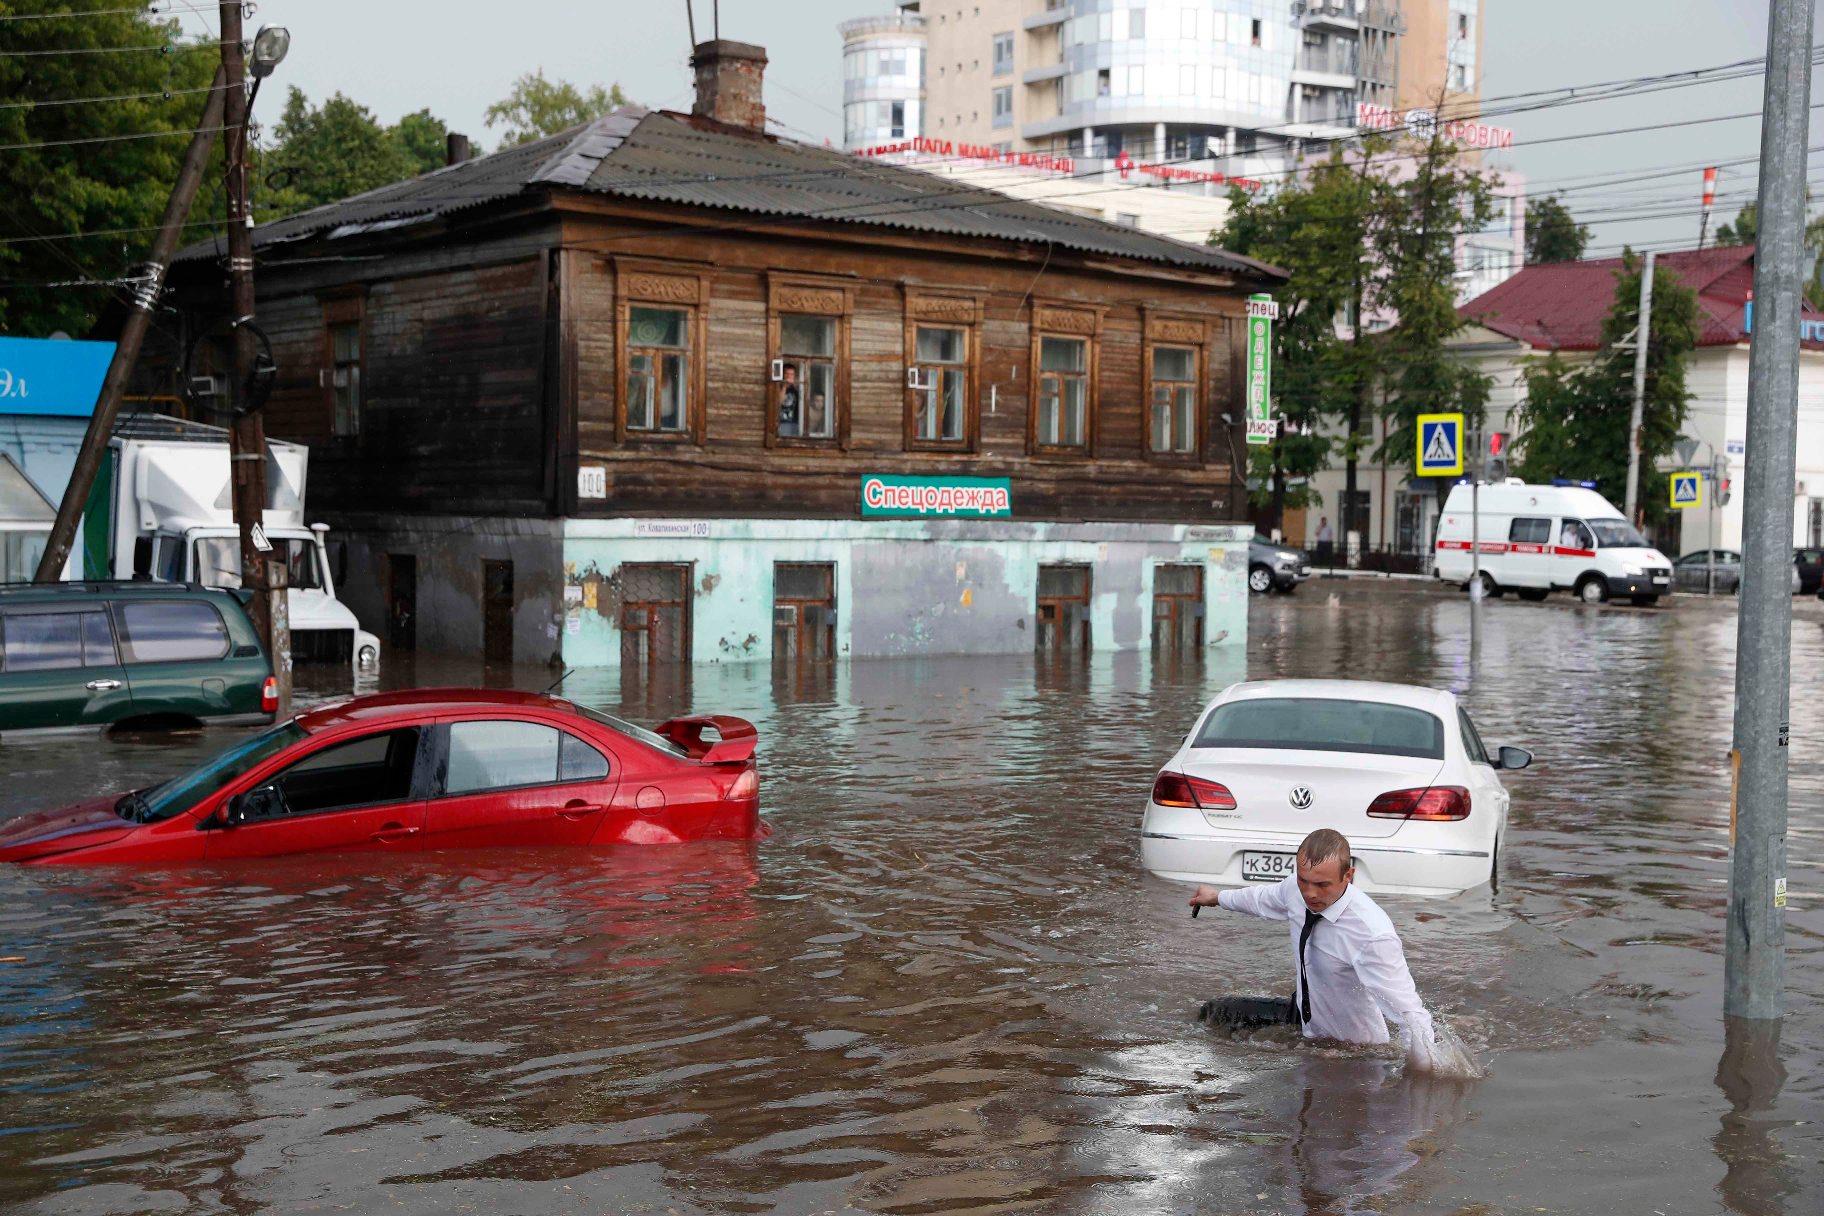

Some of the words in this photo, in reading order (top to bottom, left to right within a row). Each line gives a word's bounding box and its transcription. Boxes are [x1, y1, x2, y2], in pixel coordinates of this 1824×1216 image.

[1358, 102, 1400, 131] МИР
[913, 136, 952, 155] ПАПА
[583, 473, 602, 493] 100
[865, 479, 1009, 513] Спецодежда
[693, 523, 707, 535] 100
